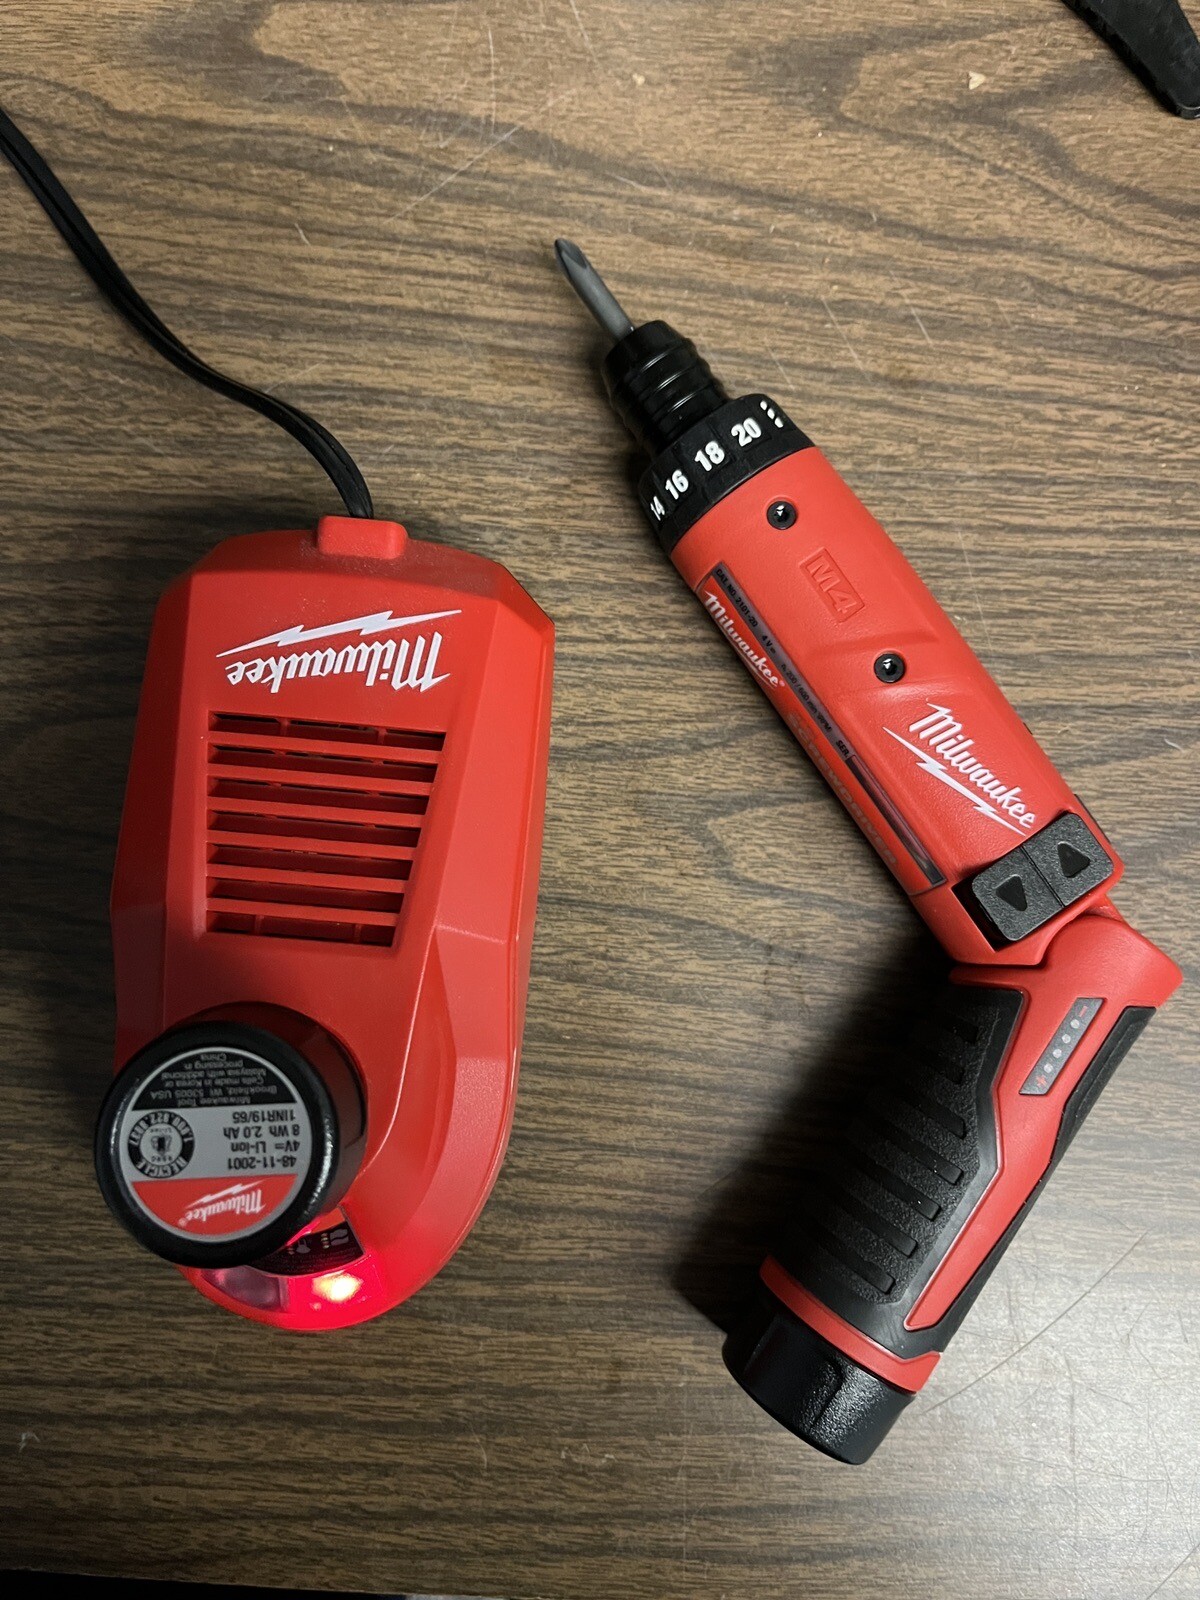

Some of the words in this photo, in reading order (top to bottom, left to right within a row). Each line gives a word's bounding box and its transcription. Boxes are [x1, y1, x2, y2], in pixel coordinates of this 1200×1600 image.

[650, 496, 665, 521] 14
[665, 469, 689, 500] 16
[694, 440, 725, 471] 18
[731, 417, 762, 447] 20
[805, 556, 856, 613] M4
[705, 590, 779, 686] Milwaukee
[225, 631, 450, 693] Milwaukee
[834, 738, 852, 758] SER.
[909, 702, 1036, 829] Milwaukee
[150, 1091, 172, 1099] USA
[200, 1096, 250, 1105] Milwaukee
[232, 1109, 295, 1123] 1INR19/65
[224, 1127, 239, 1139] Ah
[243, 1126, 262, 1138] 2.0
[269, 1125, 289, 1137] Wh
[292, 1124, 299, 1135] 8
[136, 1157, 188, 1176] RECYCLE
[228, 1156, 296, 1169] 48-11-2001
[185, 1189, 266, 1223] Milwaukee
